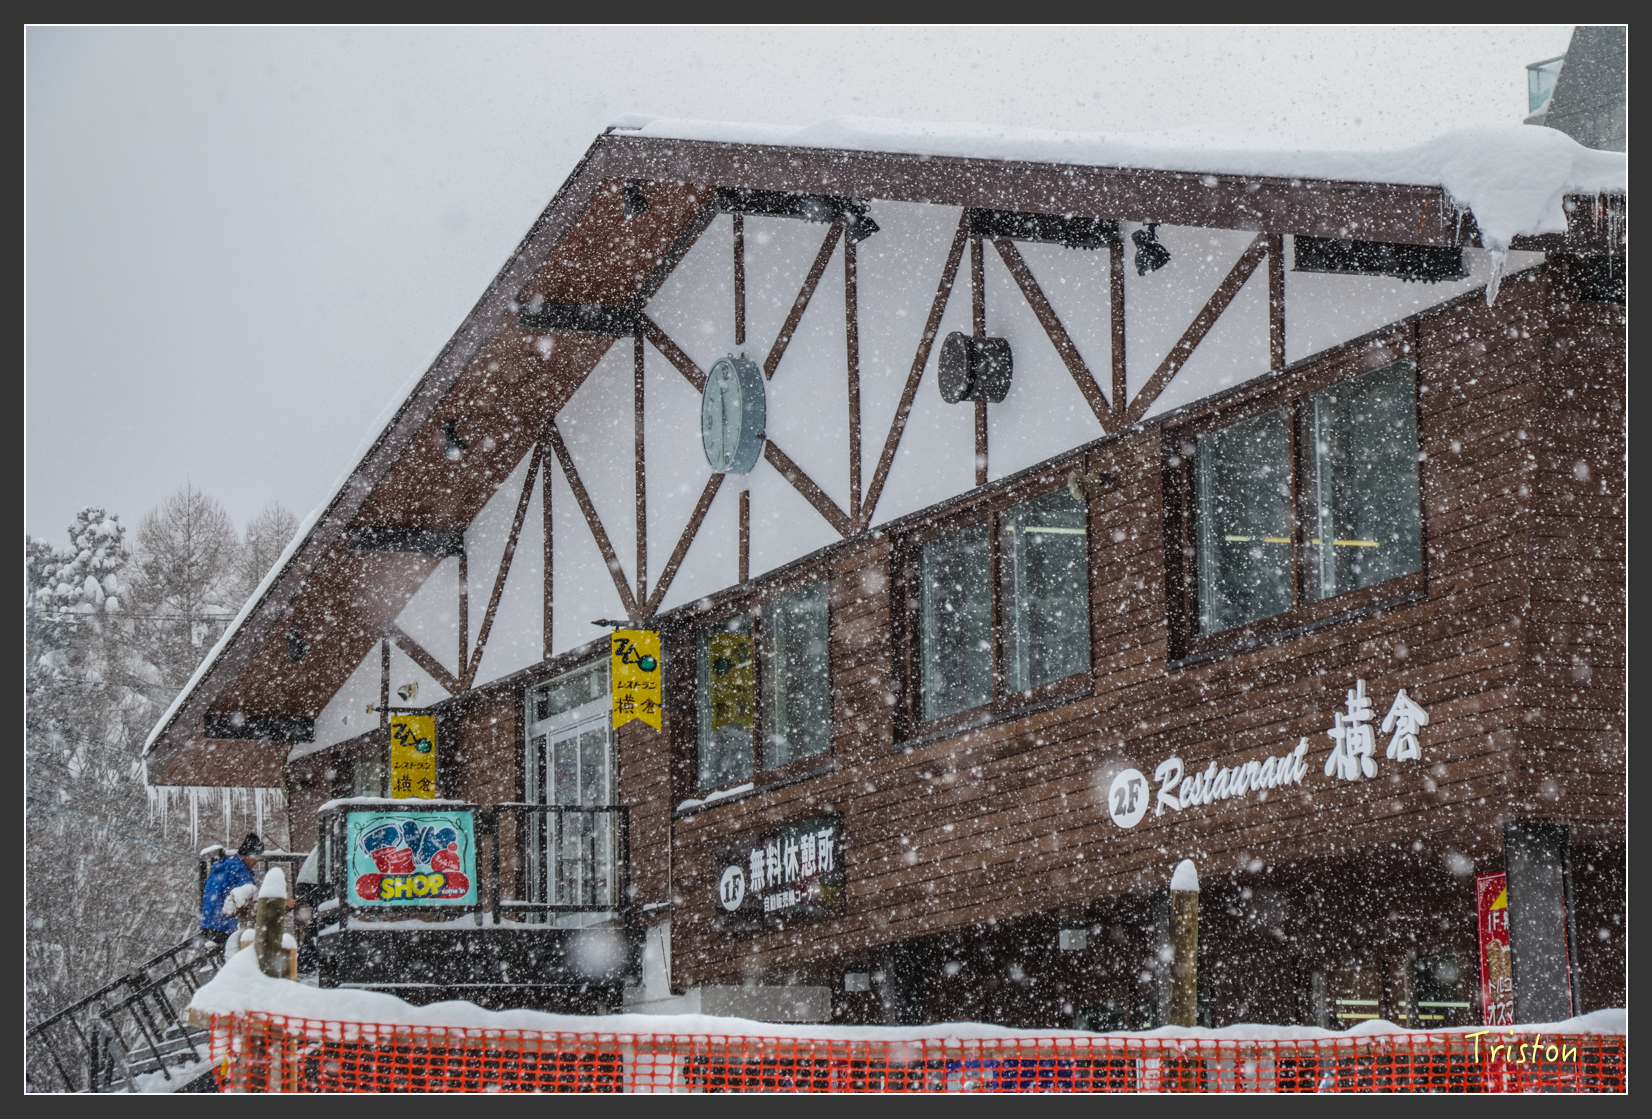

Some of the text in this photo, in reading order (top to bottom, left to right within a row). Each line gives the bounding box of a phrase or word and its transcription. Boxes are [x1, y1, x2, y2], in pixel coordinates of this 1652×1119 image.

[617, 681, 657, 690] レストラン
[614, 693, 659, 714] 横倉
[1113, 679, 1430, 817] 2F Restaurant 横倉
[394, 761, 431, 770] レストラン
[394, 772, 433, 793] 横倉
[723, 827, 835, 904] 1F 無料休憩所
[381, 873, 445, 899] SHOP
[763, 884, 821, 913] 自動販売機コーナー
